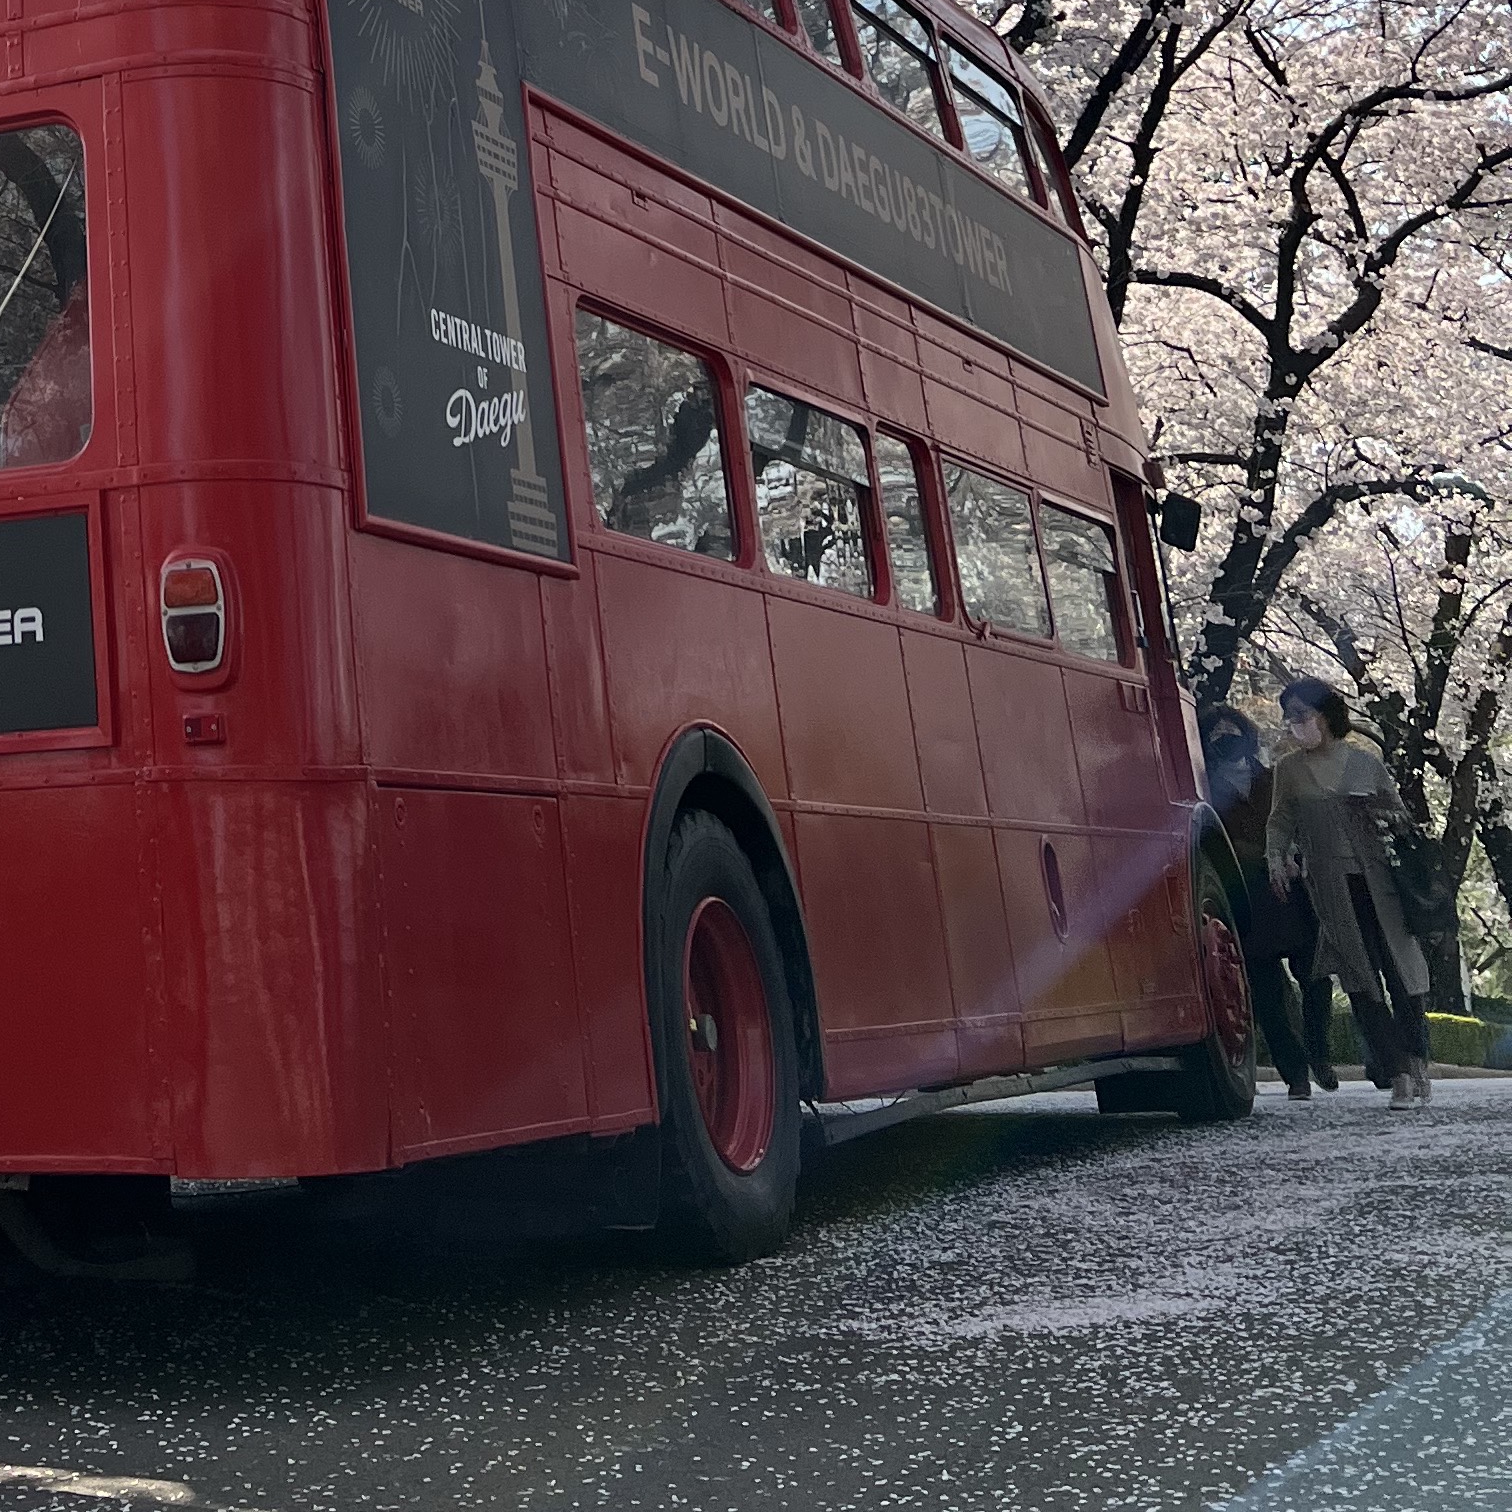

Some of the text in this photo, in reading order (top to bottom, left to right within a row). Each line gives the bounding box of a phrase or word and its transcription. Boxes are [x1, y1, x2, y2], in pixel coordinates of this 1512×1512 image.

[631, 1, 787, 161] E-WORLD
[791, 105, 818, 182] &
[430, 308, 527, 373] CENTRAL TOWER
[477, 365, 489, 390] OF
[445, 388, 527, 448] Daegu
